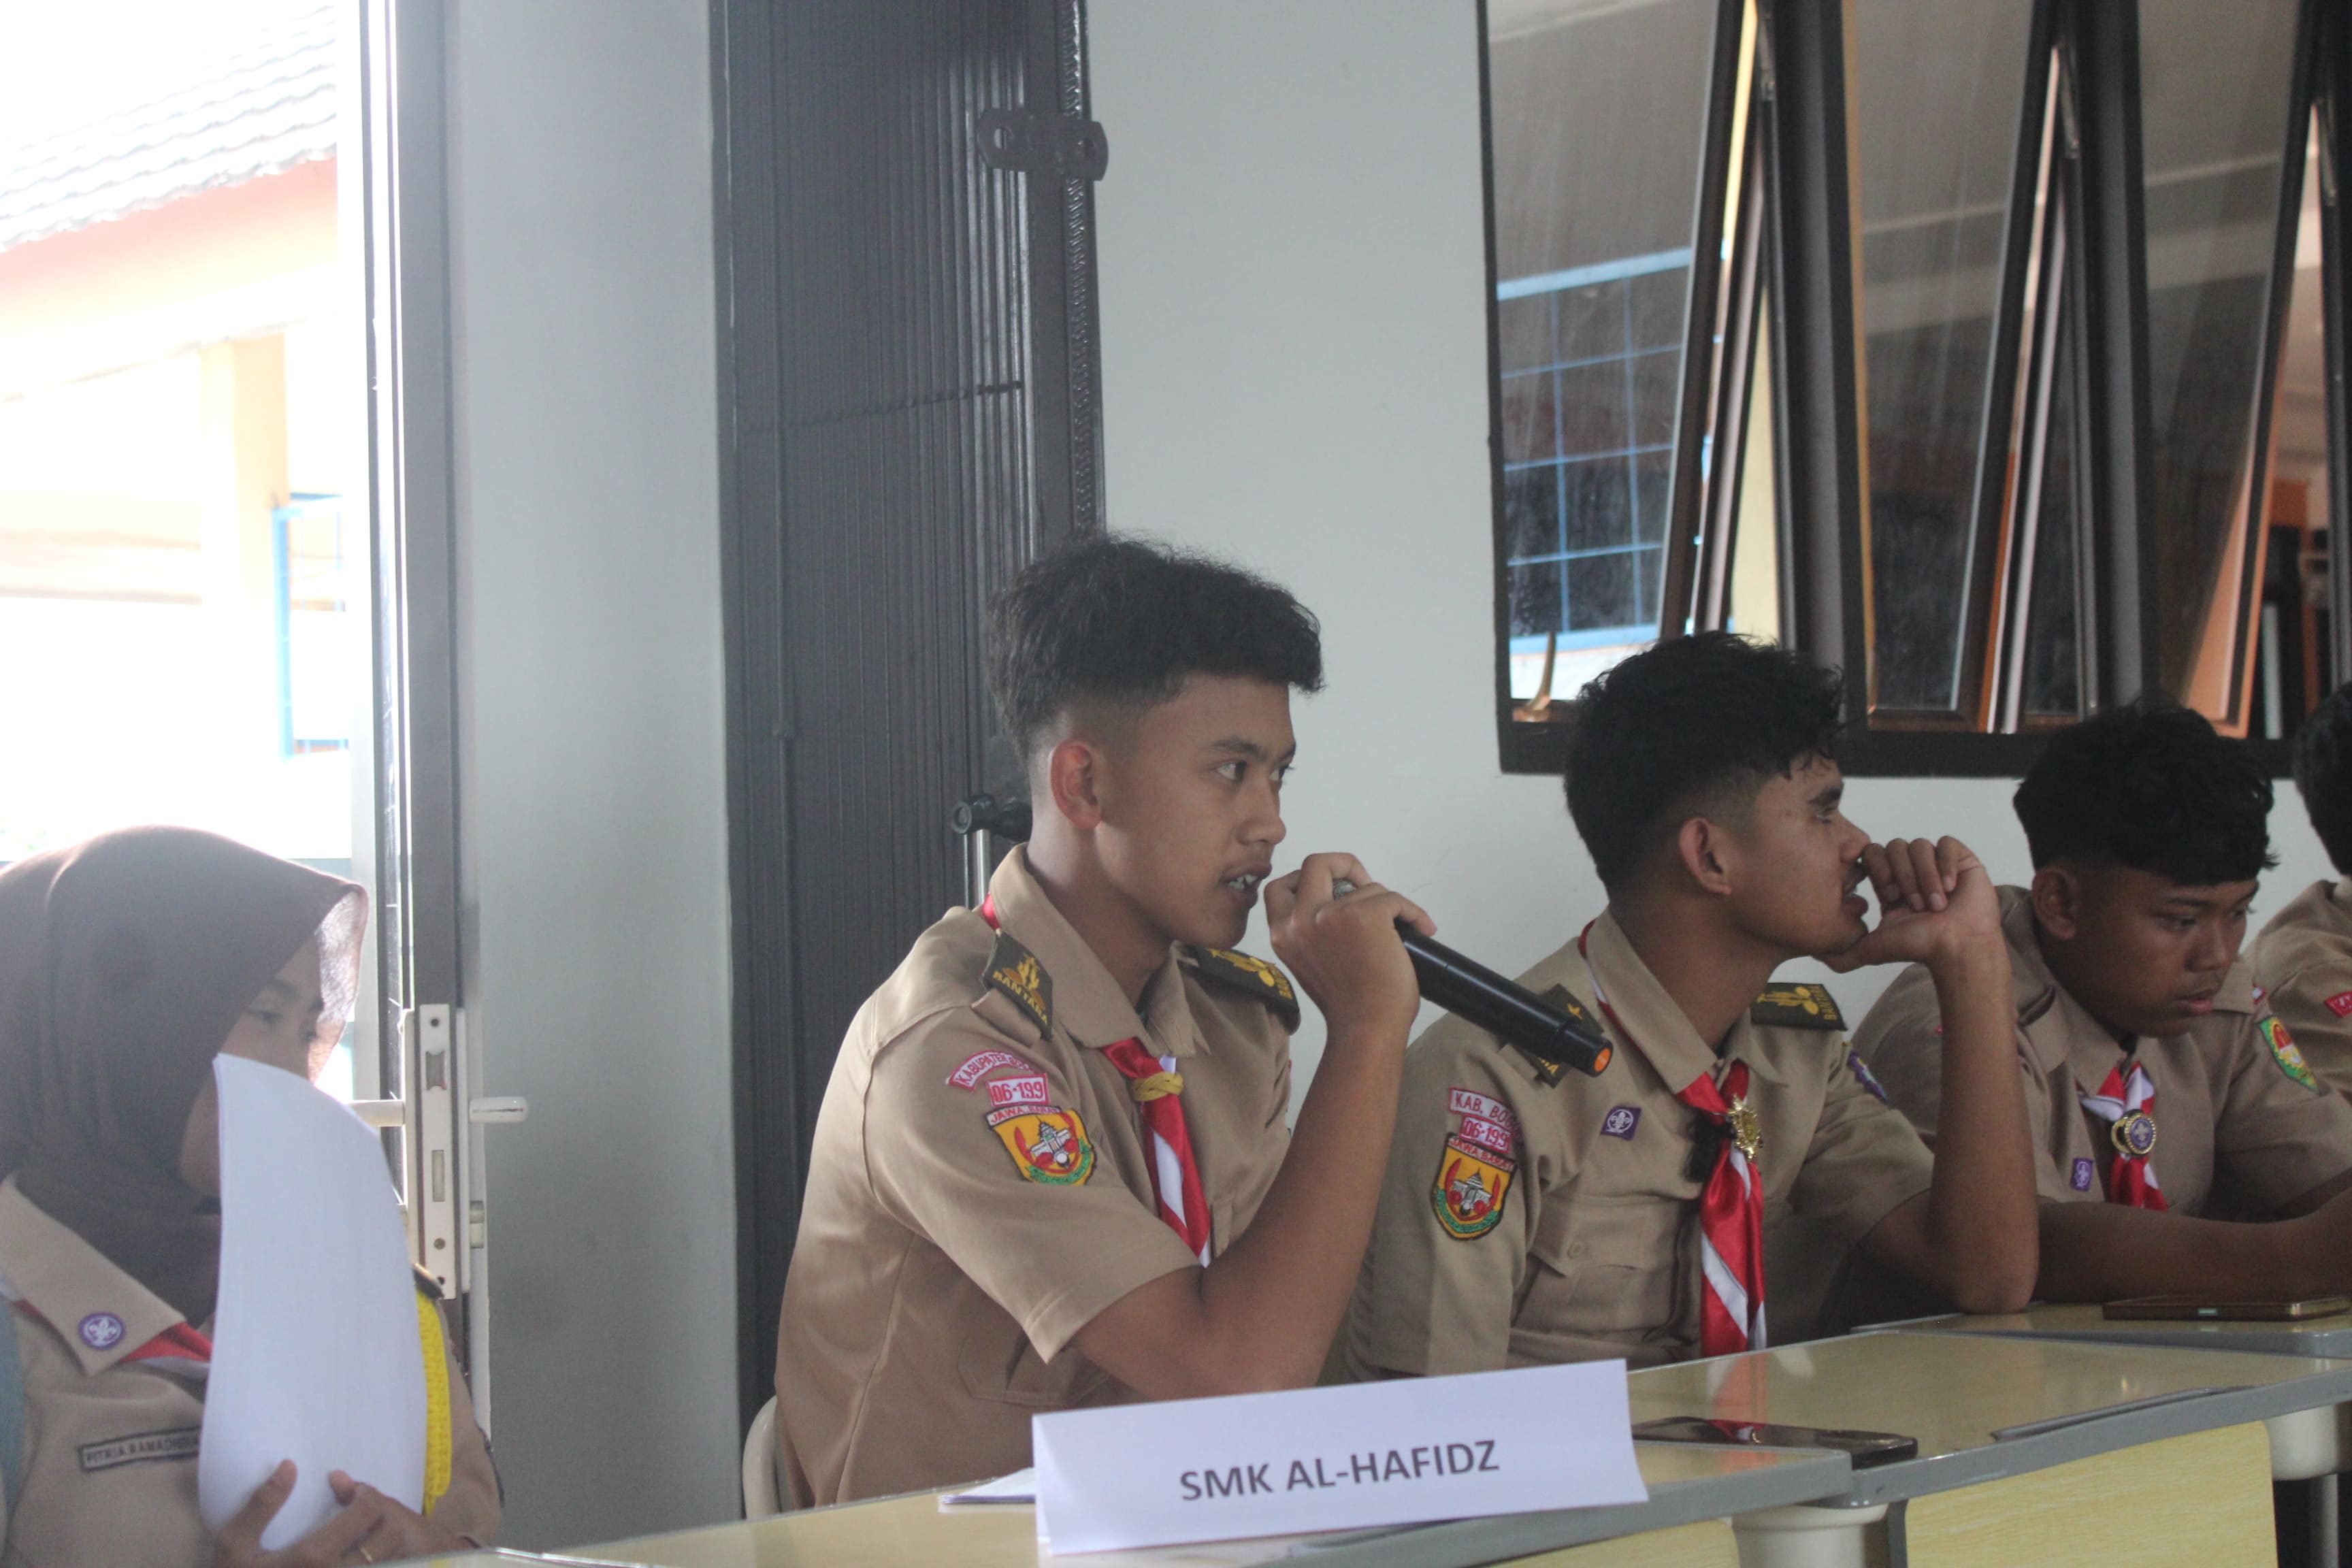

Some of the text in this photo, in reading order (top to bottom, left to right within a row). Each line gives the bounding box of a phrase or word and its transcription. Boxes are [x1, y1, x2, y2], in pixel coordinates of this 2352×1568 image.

[956, 1054, 1008, 1085] KABUPATEN
[992, 1081, 1044, 1102] 06-199
[991, 1106, 1024, 1123] JAWA
[1180, 1439, 1500, 1501] SMK AL-HAFIDZ
